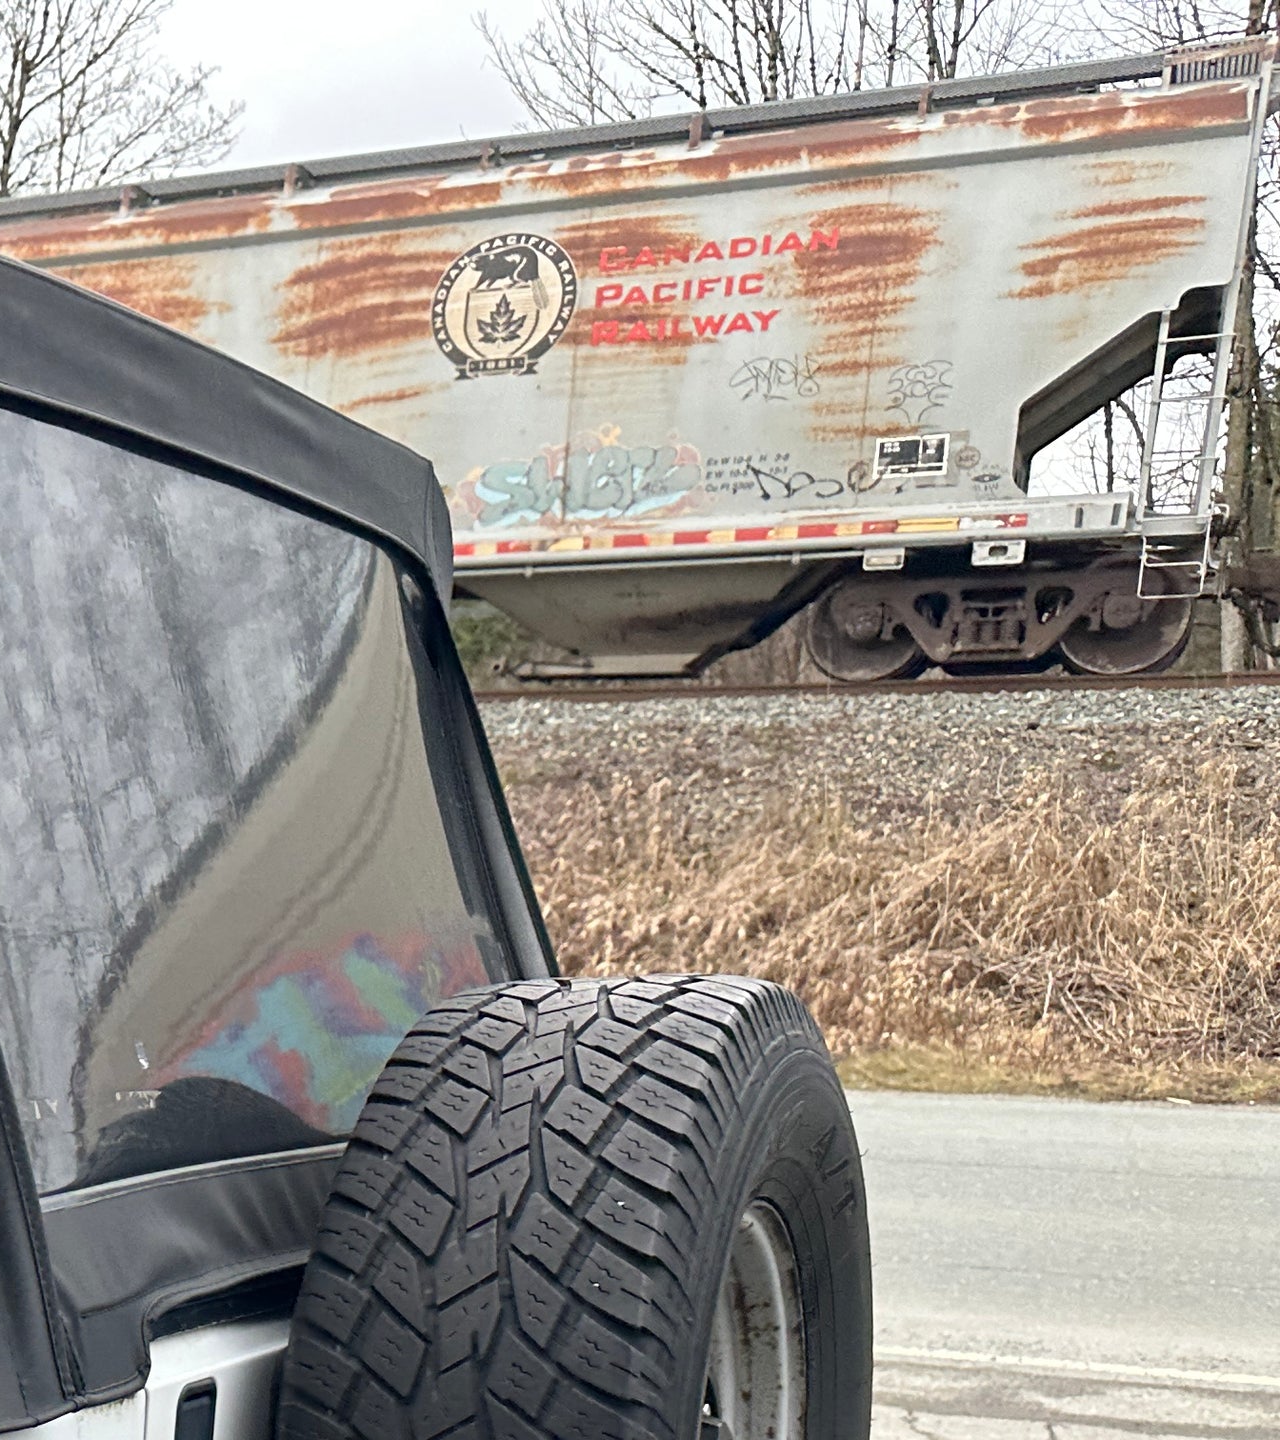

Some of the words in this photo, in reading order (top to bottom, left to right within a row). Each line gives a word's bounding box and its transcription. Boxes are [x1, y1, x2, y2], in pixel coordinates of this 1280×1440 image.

[598, 227, 840, 273] CANADIAN
[433, 255, 472, 353] CANADIAN
[479, 234, 558, 256] PACIFIC
[547, 260, 575, 344] RAILWAY
[594, 273, 765, 309] PACIFIC
[590, 309, 782, 347] RAILWAY
